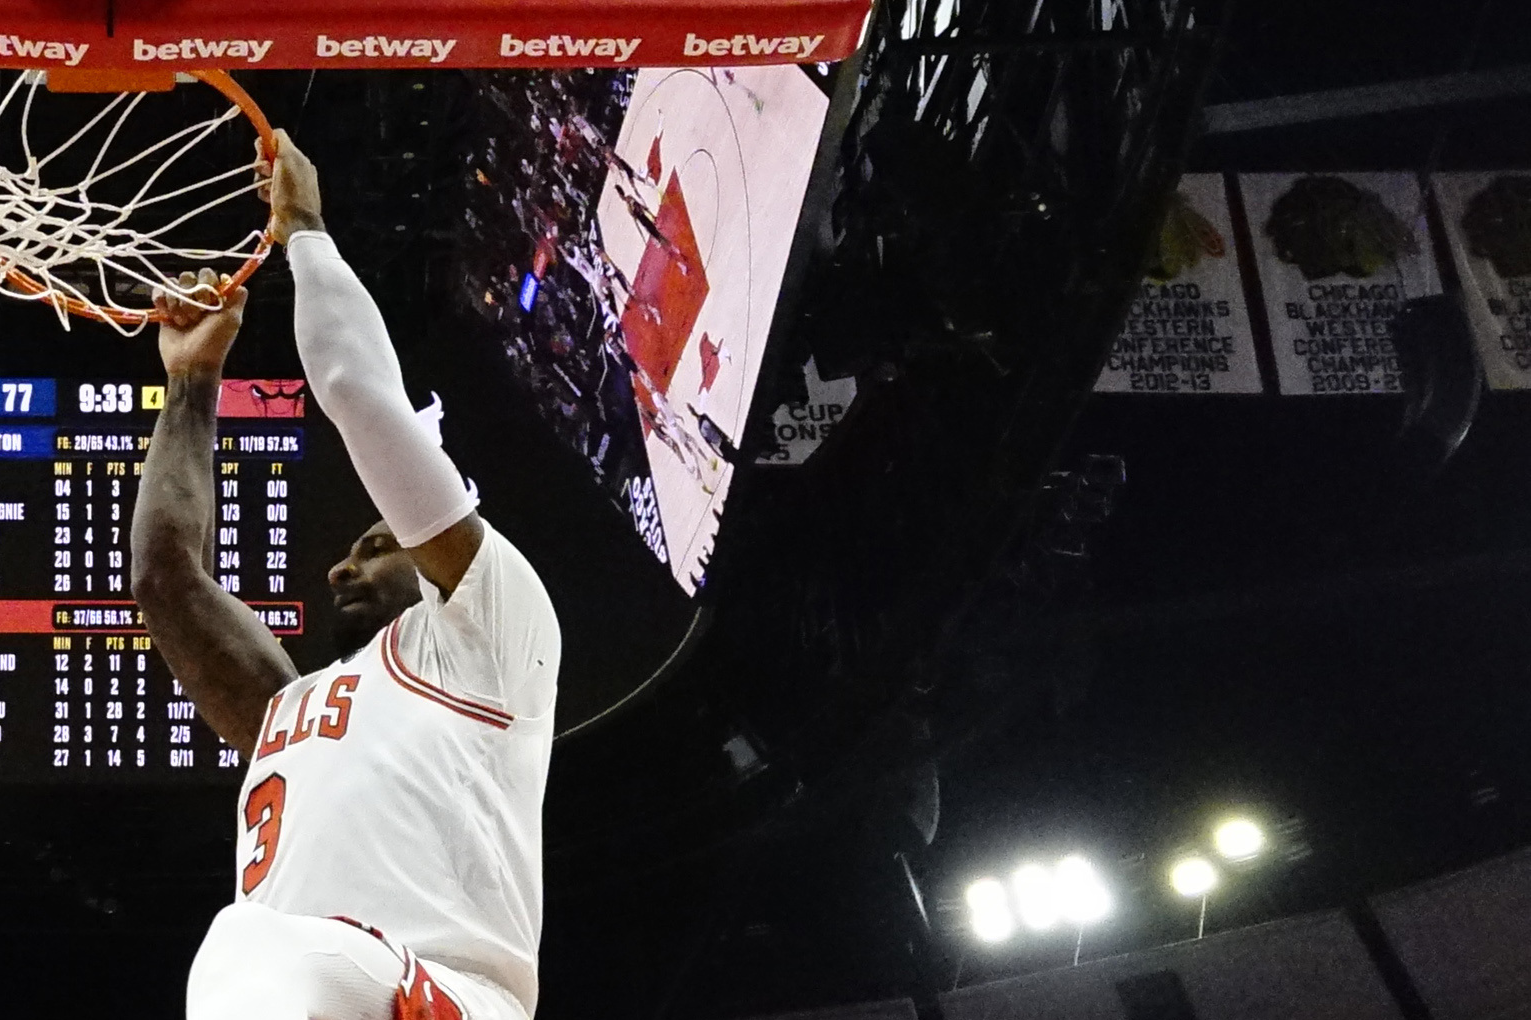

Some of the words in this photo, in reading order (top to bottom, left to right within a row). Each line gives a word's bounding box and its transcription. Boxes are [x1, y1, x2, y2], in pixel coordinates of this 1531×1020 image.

[133, 36, 273, 62] betway
[316, 35, 457, 62] betway
[499, 32, 642, 61] betway
[683, 30, 825, 58] betway
[2, 384, 32, 412] 77
[79, 384, 132, 412] 9:33
[150, 391, 158, 406] 4
[74, 435, 103, 452] 28/65
[105, 436, 133, 450] 43.1%
[267, 437, 298, 451] 57.9%
[54, 462, 72, 475] MIN
[107, 462, 125, 475] PTS
[222, 463, 238, 474] 3PT
[272, 463, 282, 474] FT
[74, 610, 102, 626] 37/66
[104, 610, 132, 624] 56.1%
[268, 611, 297, 625] 66.7%
[257, 674, 361, 760] LLS
[241, 771, 287, 897] 3
